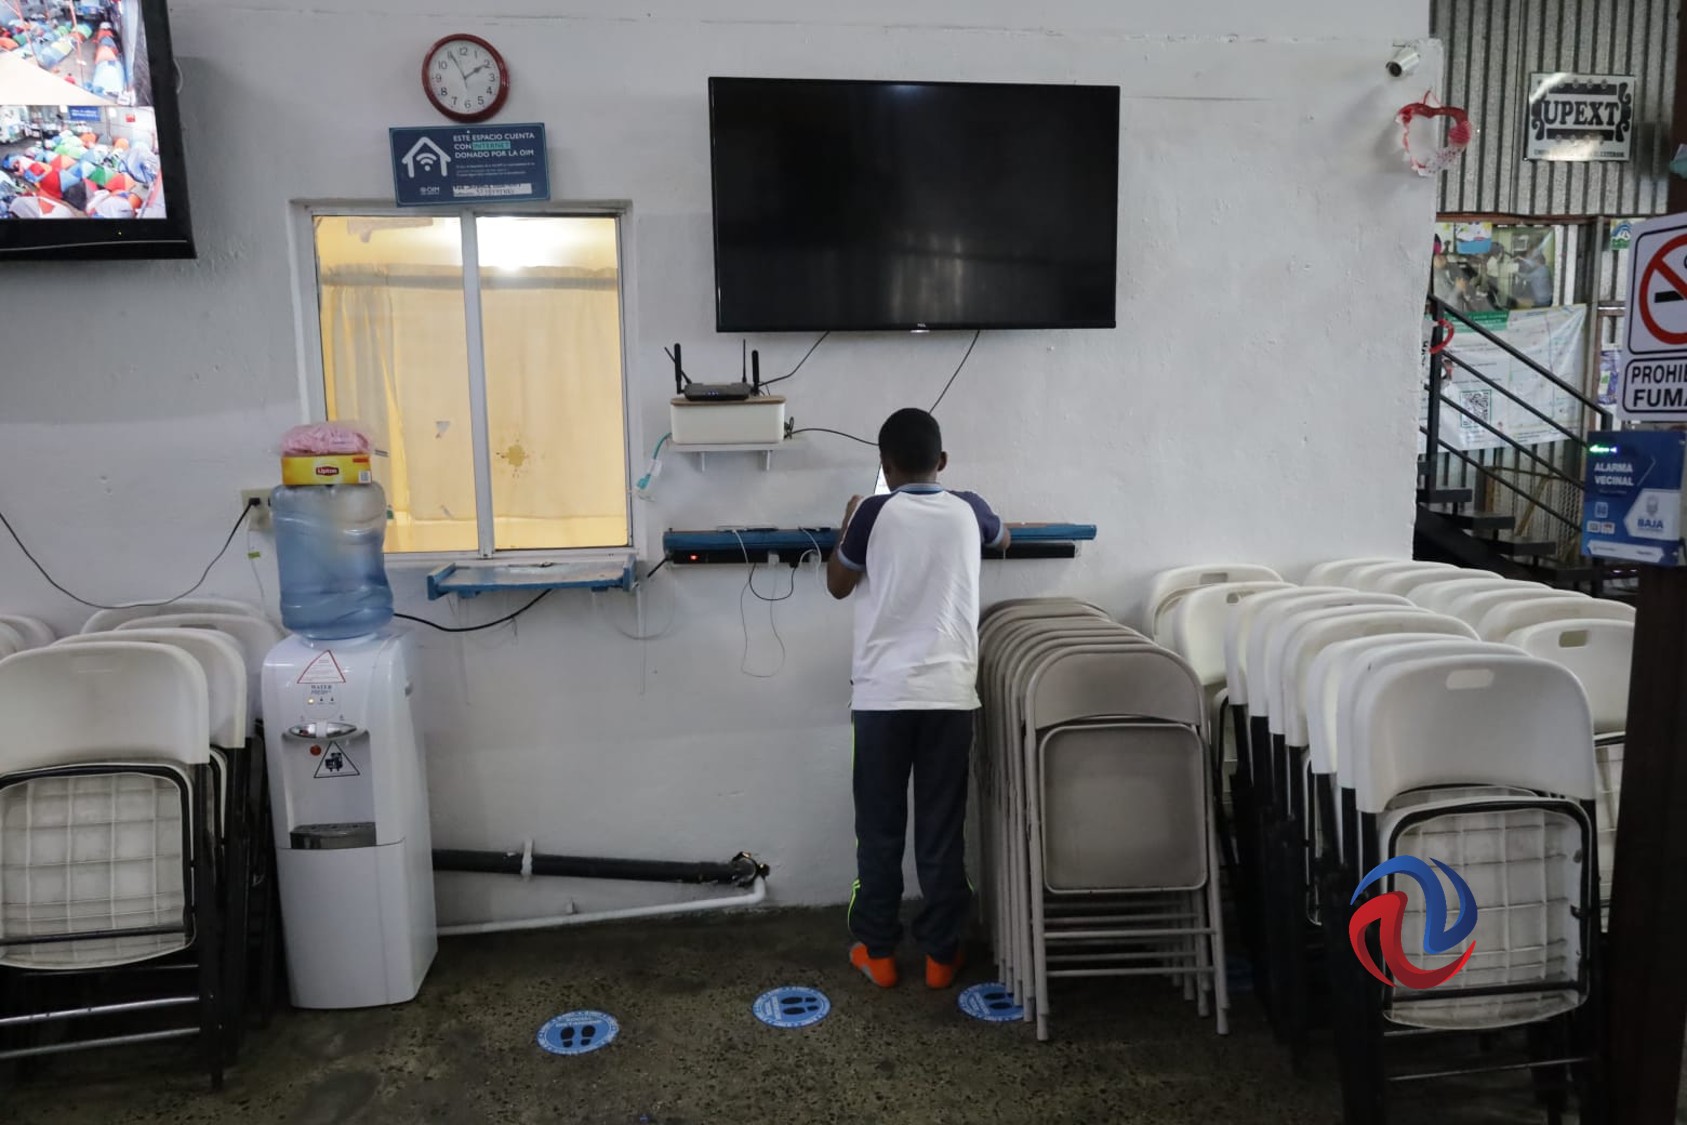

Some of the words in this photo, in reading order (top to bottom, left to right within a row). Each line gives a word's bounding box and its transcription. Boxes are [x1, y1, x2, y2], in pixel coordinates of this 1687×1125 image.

[460, 47, 468, 56] 12
[438, 60, 448, 70] 10
[435, 73, 442, 82] 9
[489, 73, 496, 82] 3
[441, 87, 448, 96] 8
[486, 86, 493, 95] 4
[451, 96, 458, 105] 7
[464, 100, 472, 109] 6
[478, 96, 485, 105] 5
[1541, 100, 1619, 126] UPEXT
[472, 133, 503, 141] ESPACIO
[504, 132, 535, 140] CUENTA
[455, 151, 490, 159] DONADO
[1594, 462, 1633, 472] ALARMA
[1594, 475, 1634, 486] VECINAL
[1637, 518, 1663, 528] BAJA
